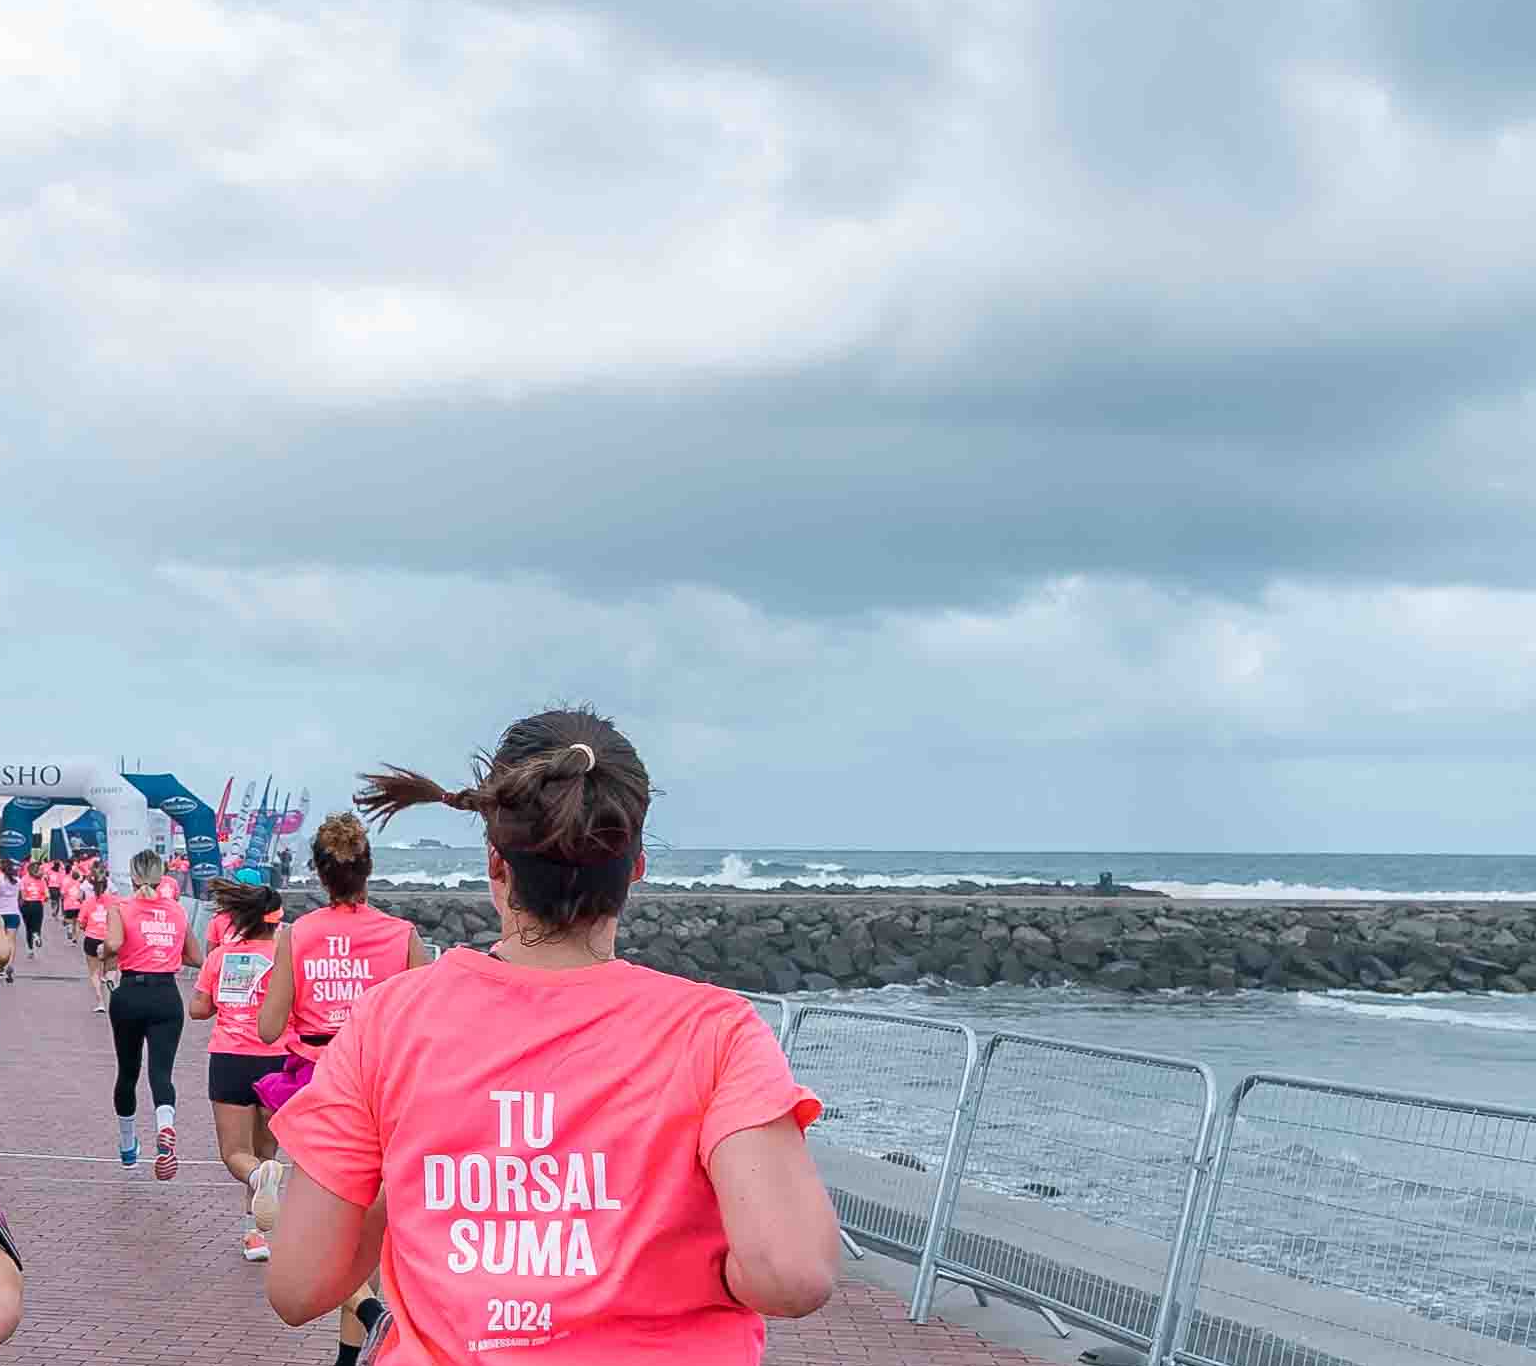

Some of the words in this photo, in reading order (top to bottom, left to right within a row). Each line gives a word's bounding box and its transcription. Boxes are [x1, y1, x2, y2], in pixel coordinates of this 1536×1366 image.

[325, 936, 350, 956] TU
[303, 958, 374, 980] DORSAL
[312, 980, 365, 1002] SUMA
[488, 1090, 555, 1149] TU
[423, 1153, 622, 1212] DORSAL
[447, 1218, 597, 1277] SUMA
[487, 1298, 552, 1332] 2024
